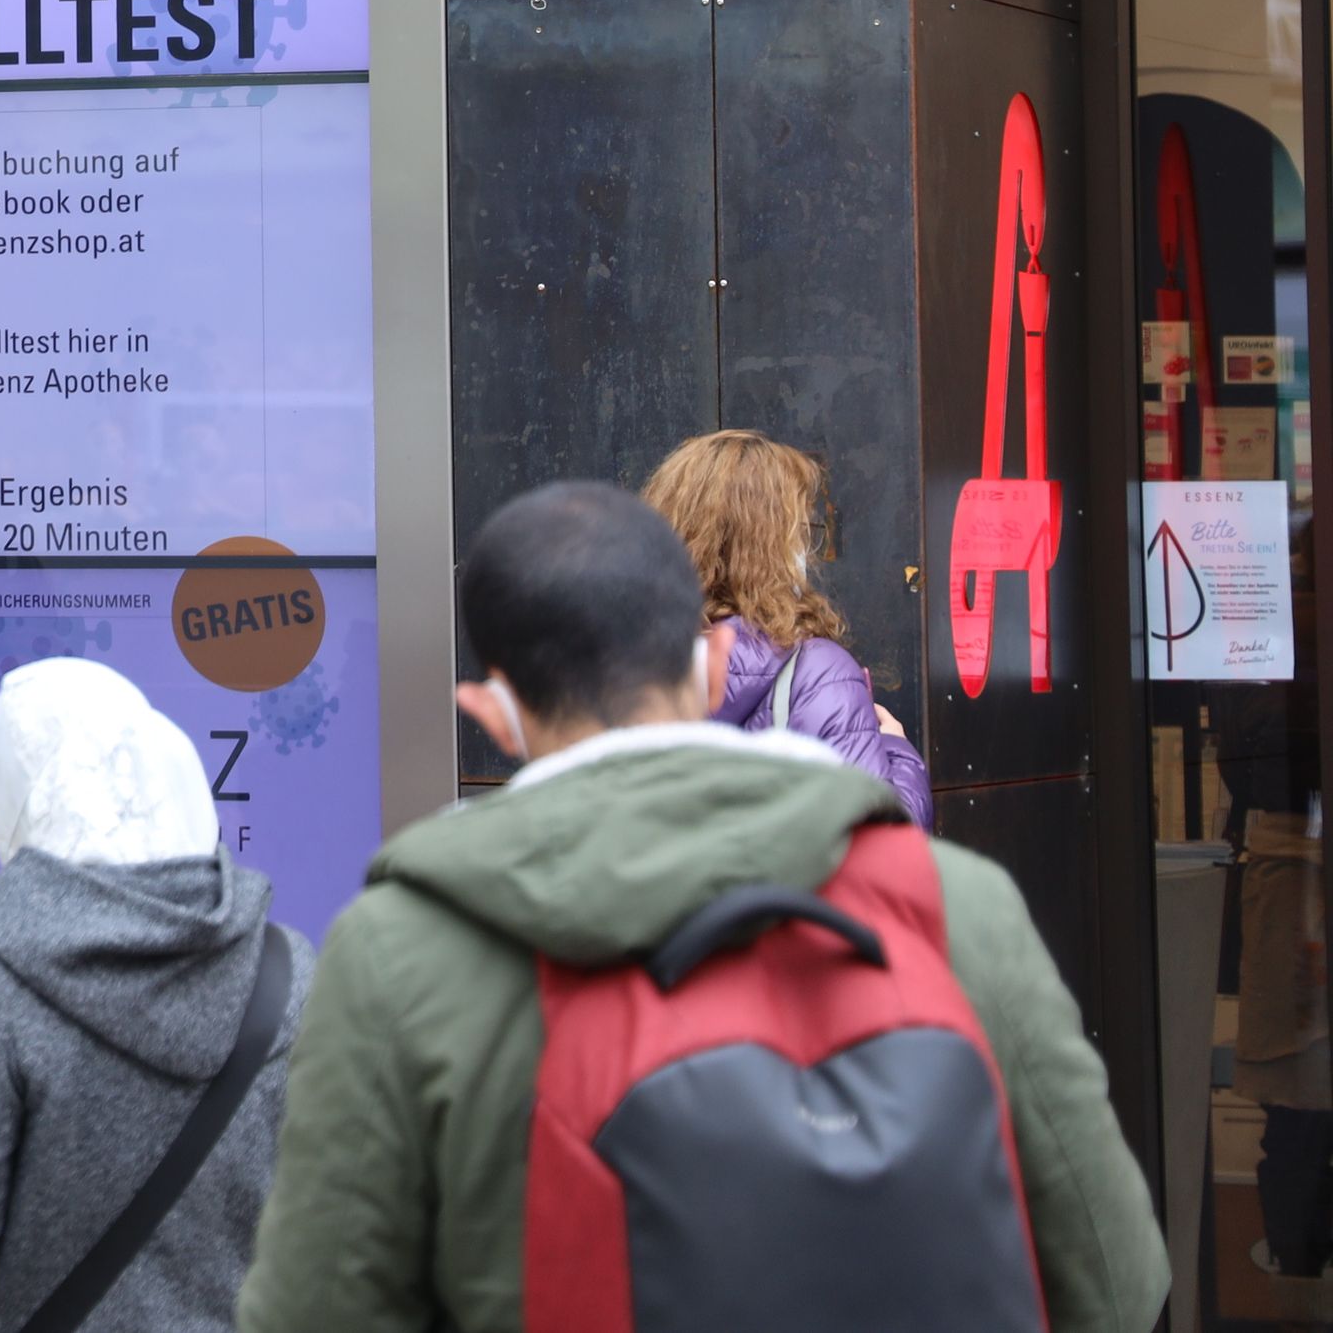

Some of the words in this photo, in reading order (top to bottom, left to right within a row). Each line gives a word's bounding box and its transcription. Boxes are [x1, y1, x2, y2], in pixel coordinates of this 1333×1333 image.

[135, 147, 179, 173] auf
[80, 188, 144, 213] oder
[68, 328, 119, 353] hier
[127, 327, 149, 353] in
[43, 367, 169, 399] Apotheke
[0, 477, 128, 513] Ergebnis
[1185, 491, 1245, 502] ESSENZ
[3, 524, 35, 551] 20
[46, 522, 168, 551] Minuten
[1191, 519, 1238, 541] Bitte
[181, 588, 315, 645] GRATIS
